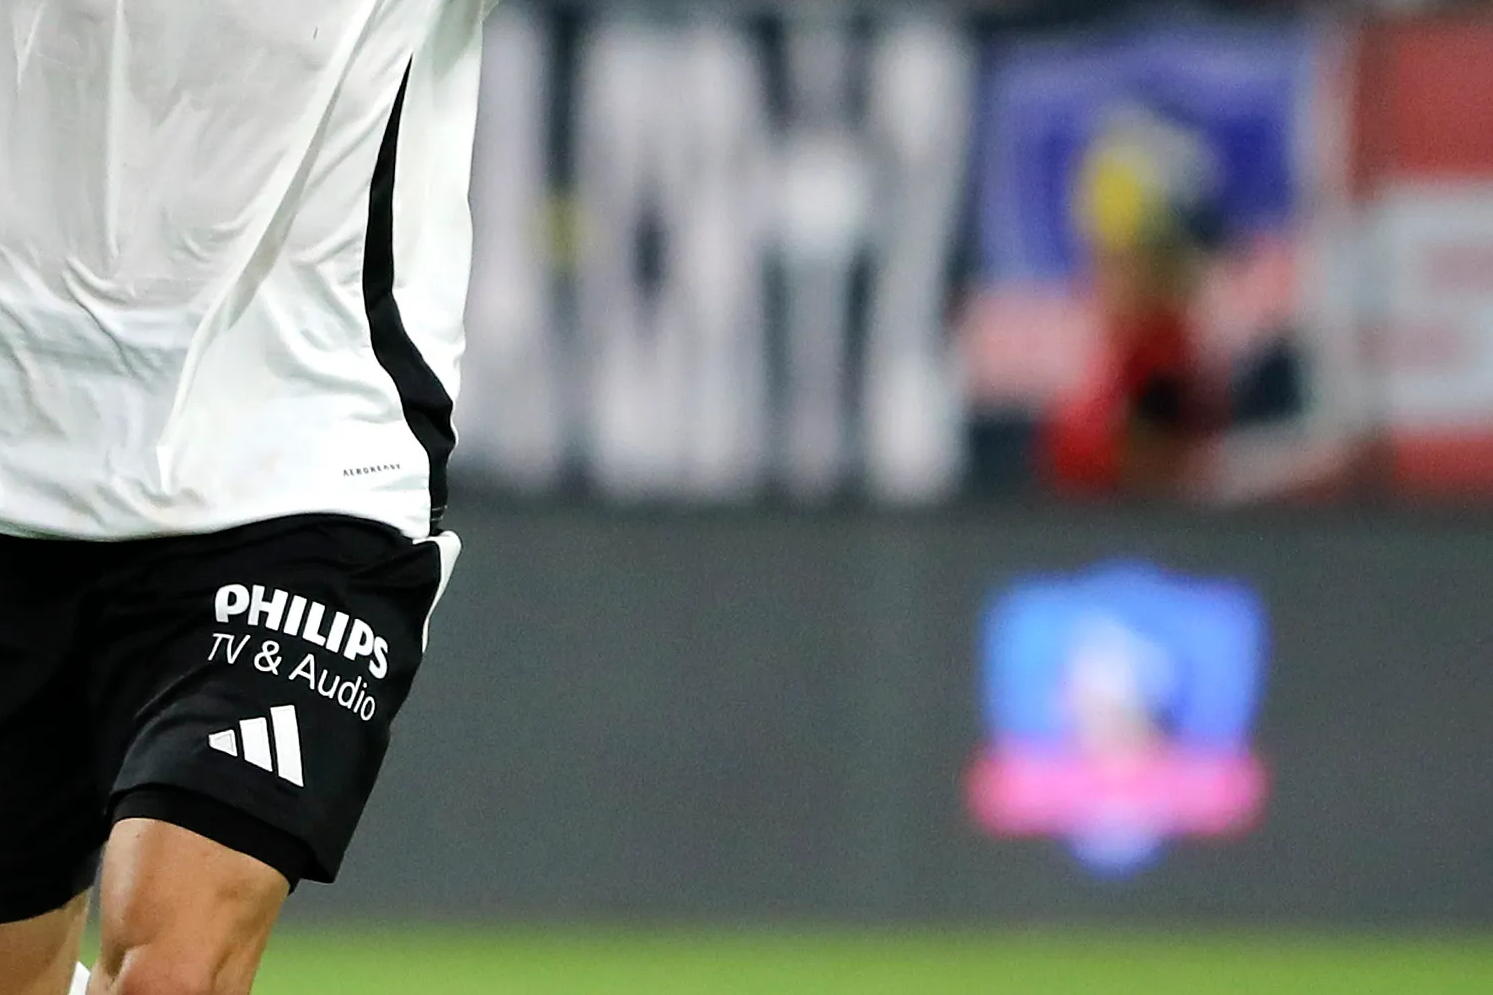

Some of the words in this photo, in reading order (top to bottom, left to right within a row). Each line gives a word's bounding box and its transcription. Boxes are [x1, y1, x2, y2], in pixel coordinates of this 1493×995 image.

[207, 632, 251, 665] TV
[253, 640, 283, 676] &
[288, 653, 376, 722] Audio
[214, 583, 389, 680] PHILIPS
